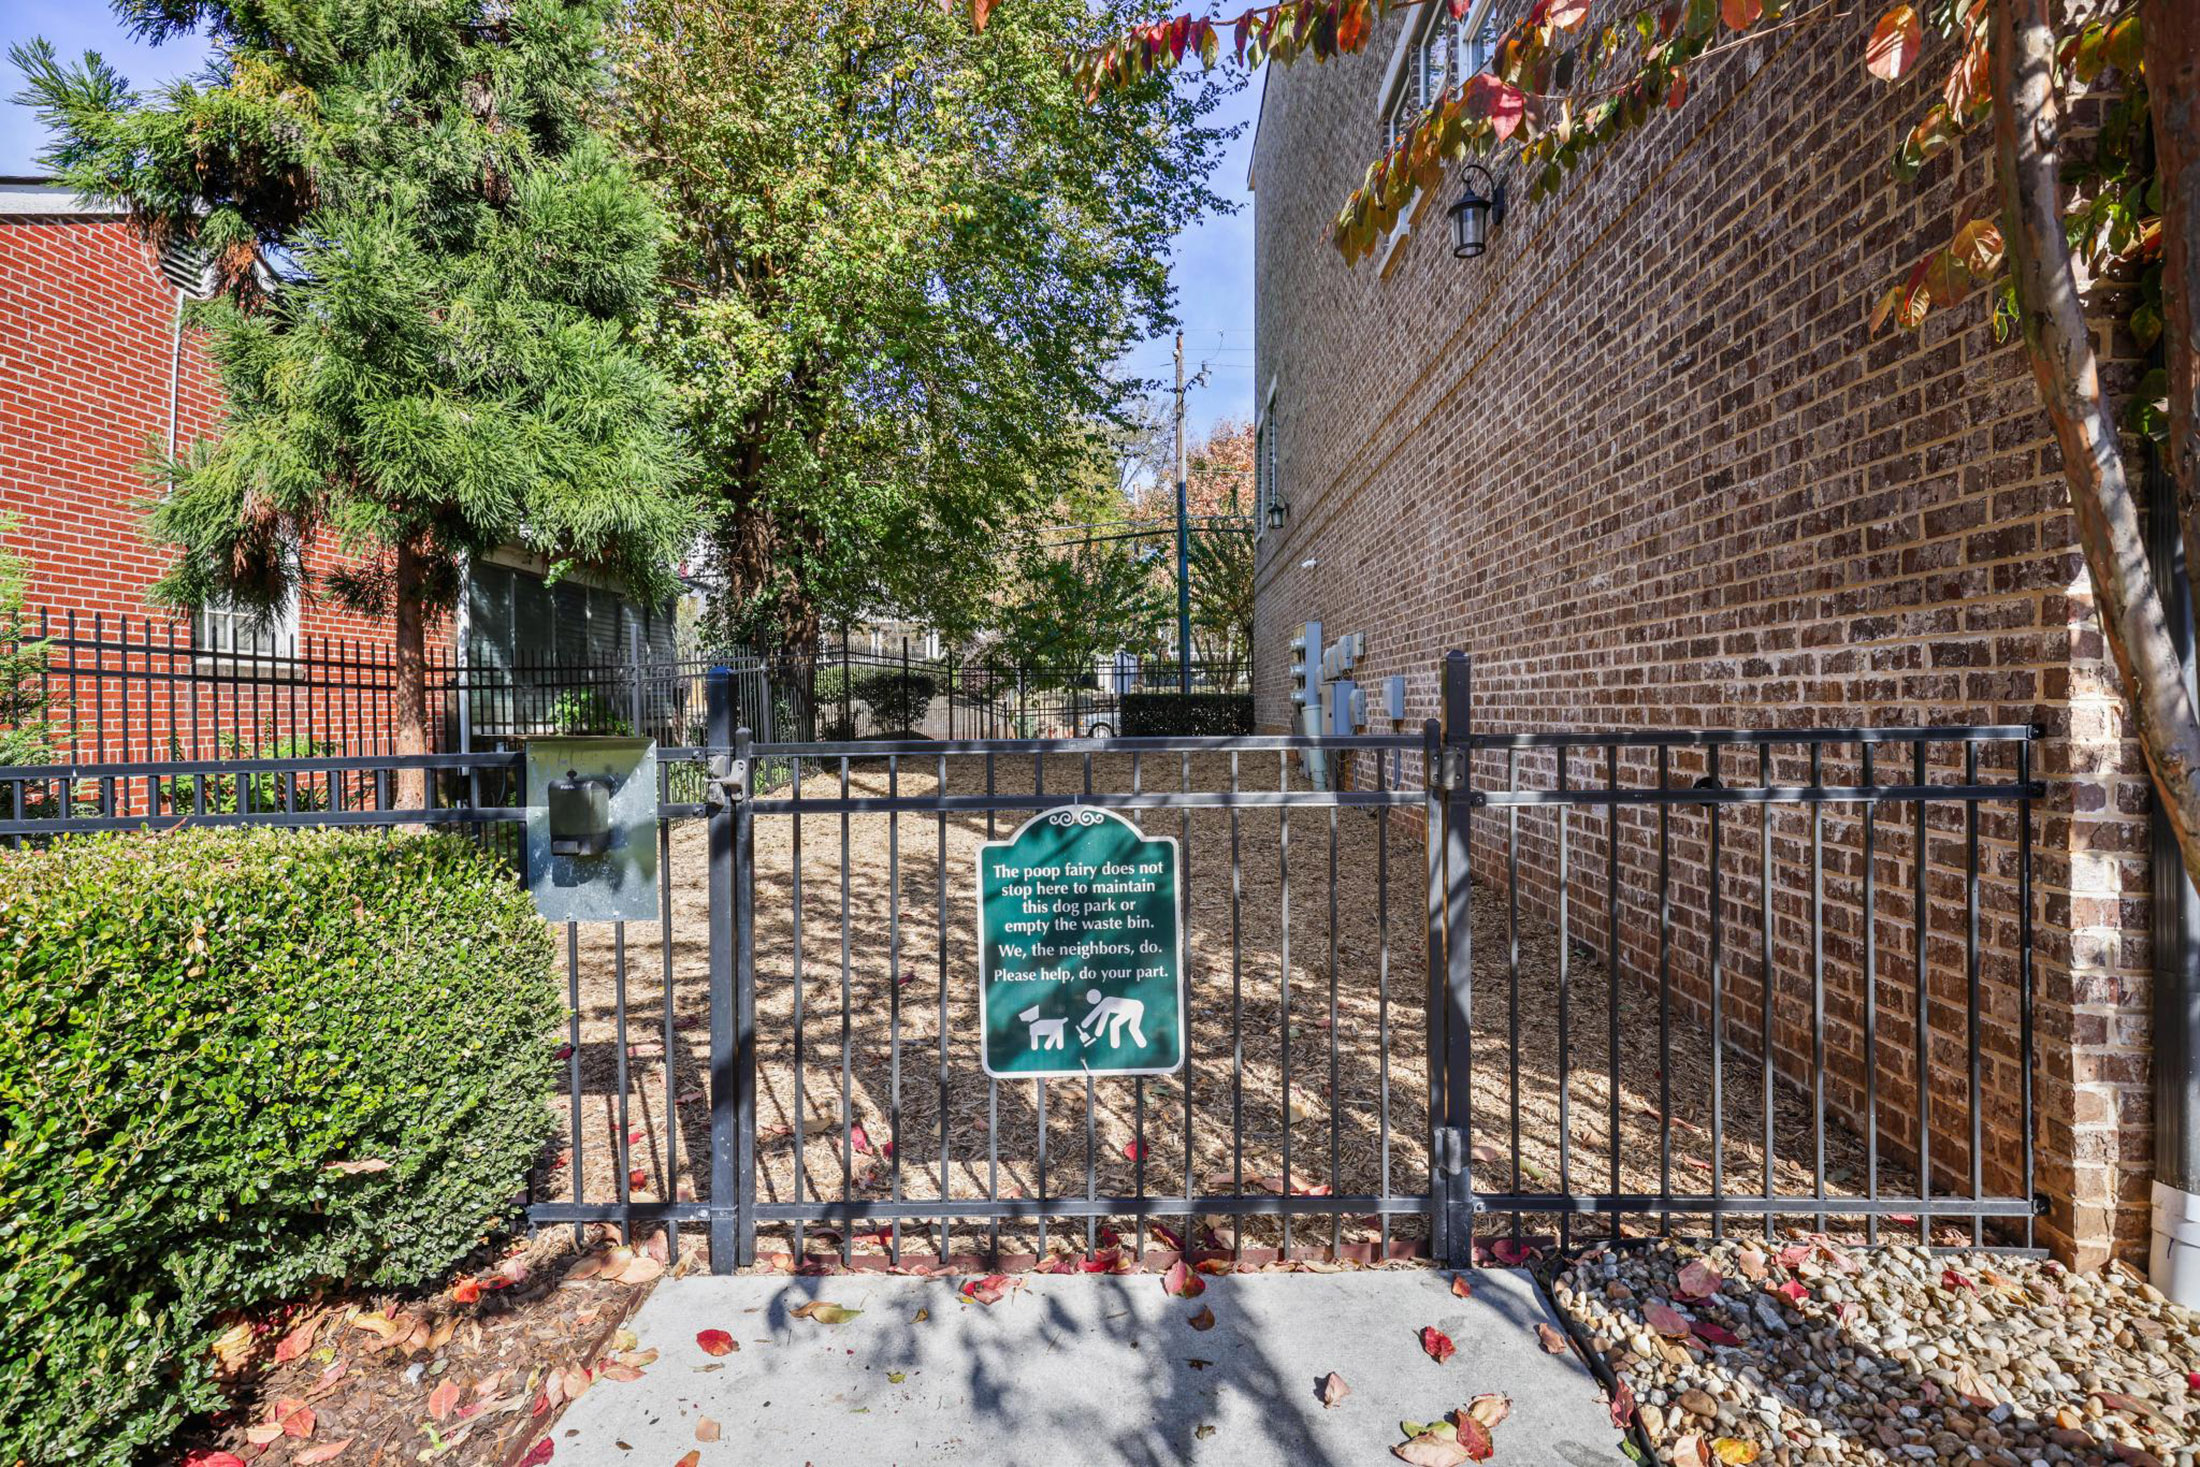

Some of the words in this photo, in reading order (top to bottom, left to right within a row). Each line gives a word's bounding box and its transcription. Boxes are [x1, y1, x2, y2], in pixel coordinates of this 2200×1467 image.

[994, 865, 1019, 878] The
[1024, 865, 1060, 880] poop
[1065, 862, 1097, 879] fairy
[1102, 862, 1135, 875] does
[1140, 861, 1163, 874] not
[1002, 882, 1032, 899] stop
[1036, 882, 1068, 895] here
[1073, 882, 1088, 894] to
[1092, 880, 1155, 893] maintain
[1022, 901, 1048, 914] this
[1053, 900, 1079, 916] dog
[1084, 900, 1115, 914] park
[1121, 901, 1136, 911] or
[1005, 920, 1049, 935] empty
[1055, 919, 1077, 931] the
[1082, 918, 1122, 929] waste
[1127, 916, 1154, 928] bin.
[998, 944, 1027, 959] We,
[1032, 943, 1054, 956] the
[1059, 941, 1135, 958] neighbors,
[1140, 940, 1162, 954] do.
[994, 969, 1036, 982] Please
[1041, 968, 1074, 983] help,
[1079, 967, 1096, 979] do
[1101, 967, 1132, 982] your
[1136, 966, 1168, 981] part.
